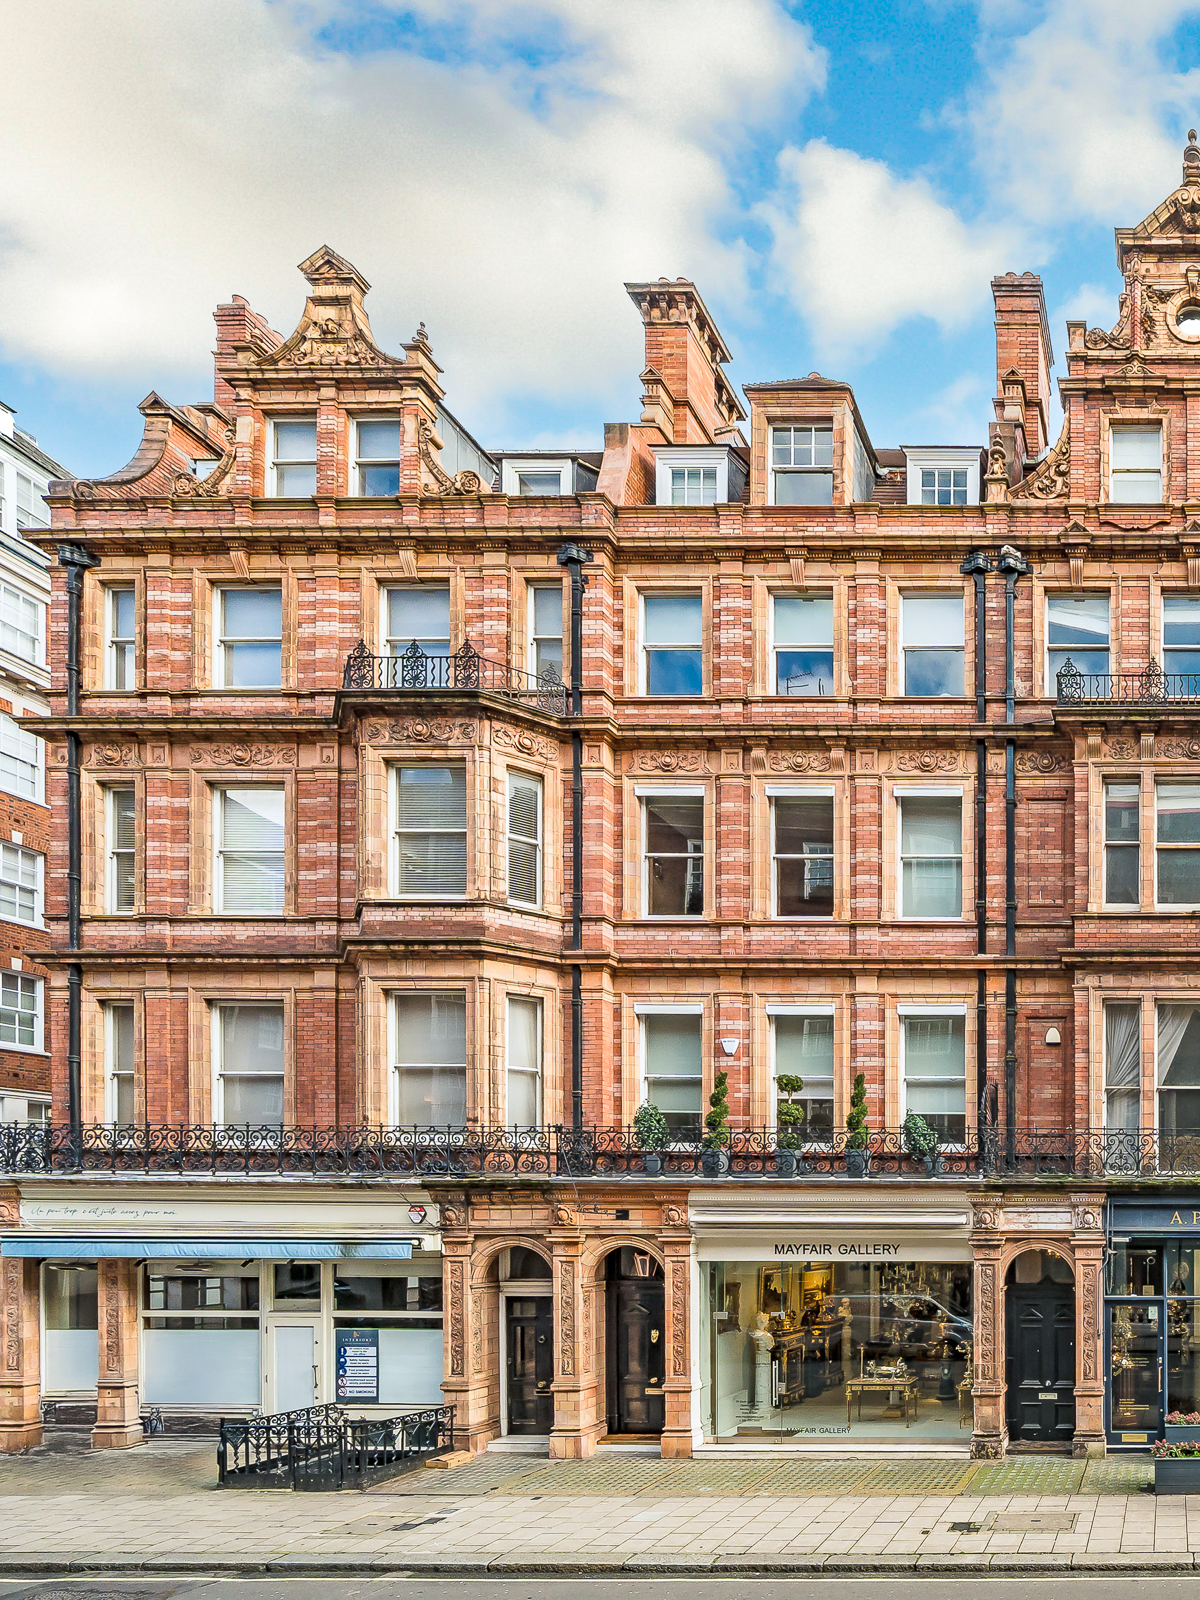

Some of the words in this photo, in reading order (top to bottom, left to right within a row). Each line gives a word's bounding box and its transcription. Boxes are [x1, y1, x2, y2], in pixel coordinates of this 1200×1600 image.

[1169, 1211, 1188, 1225] A.
[774, 1244, 832, 1255] MAYFAIR
[838, 1244, 901, 1255] GALLERY
